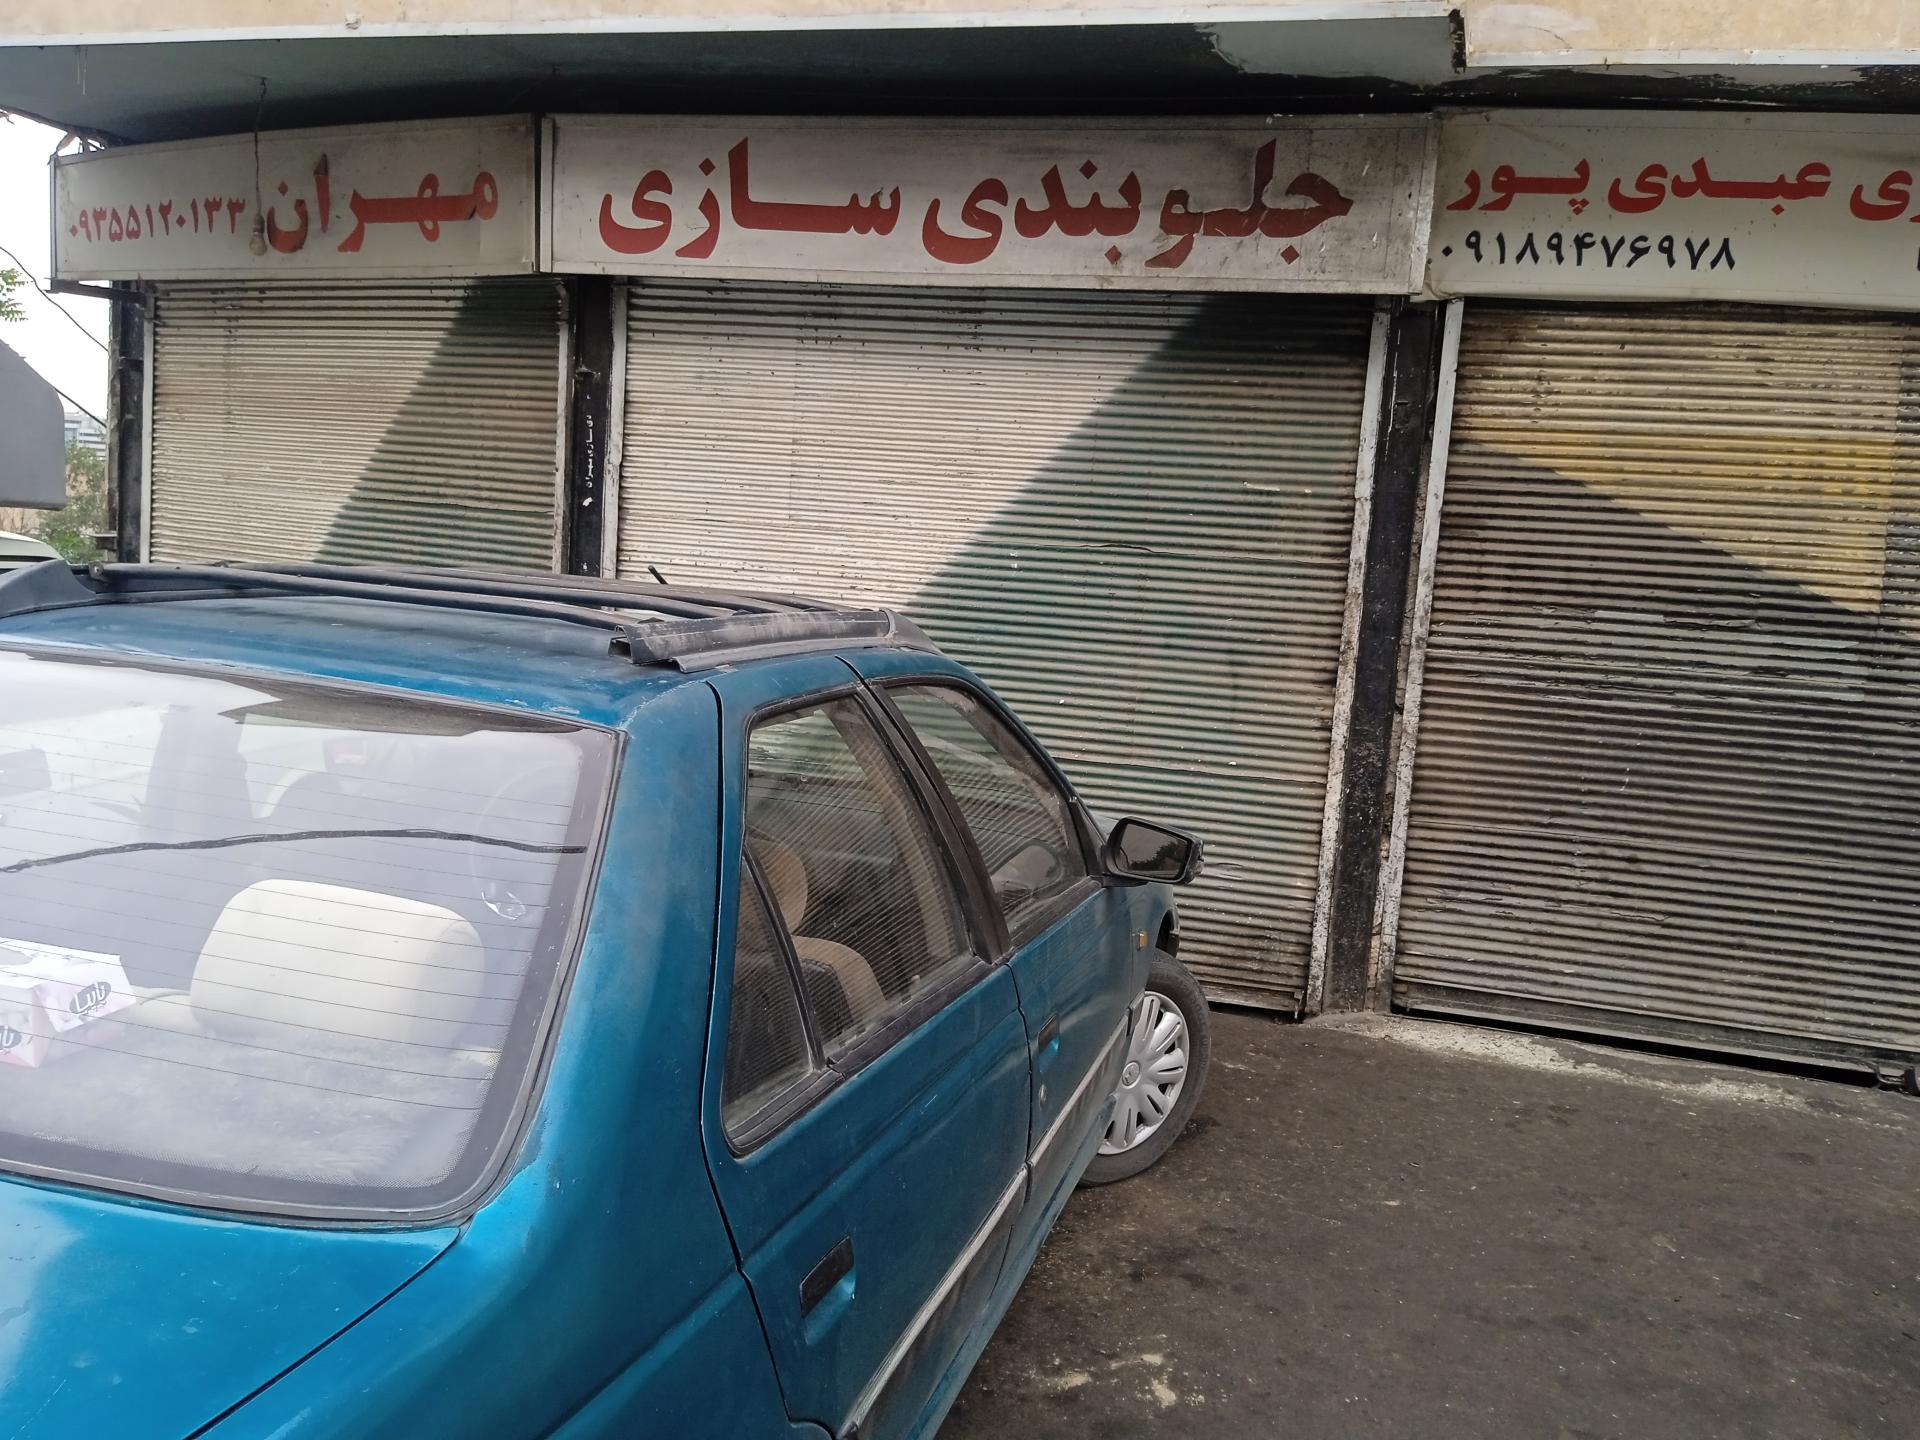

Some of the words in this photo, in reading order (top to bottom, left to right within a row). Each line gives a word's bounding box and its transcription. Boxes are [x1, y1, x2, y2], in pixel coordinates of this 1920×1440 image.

[267, 153, 498, 253] مهران
[598, 136, 900, 259] سازی
[1446, 157, 1591, 216] پور
[1608, 157, 1831, 216] عبدی
[69, 197, 246, 243] ۰۹۳۵۵۱۲۰۱۳۳
[1441, 229, 1736, 271] ۰۹۱۸۹۴۷۶۹۷۸
